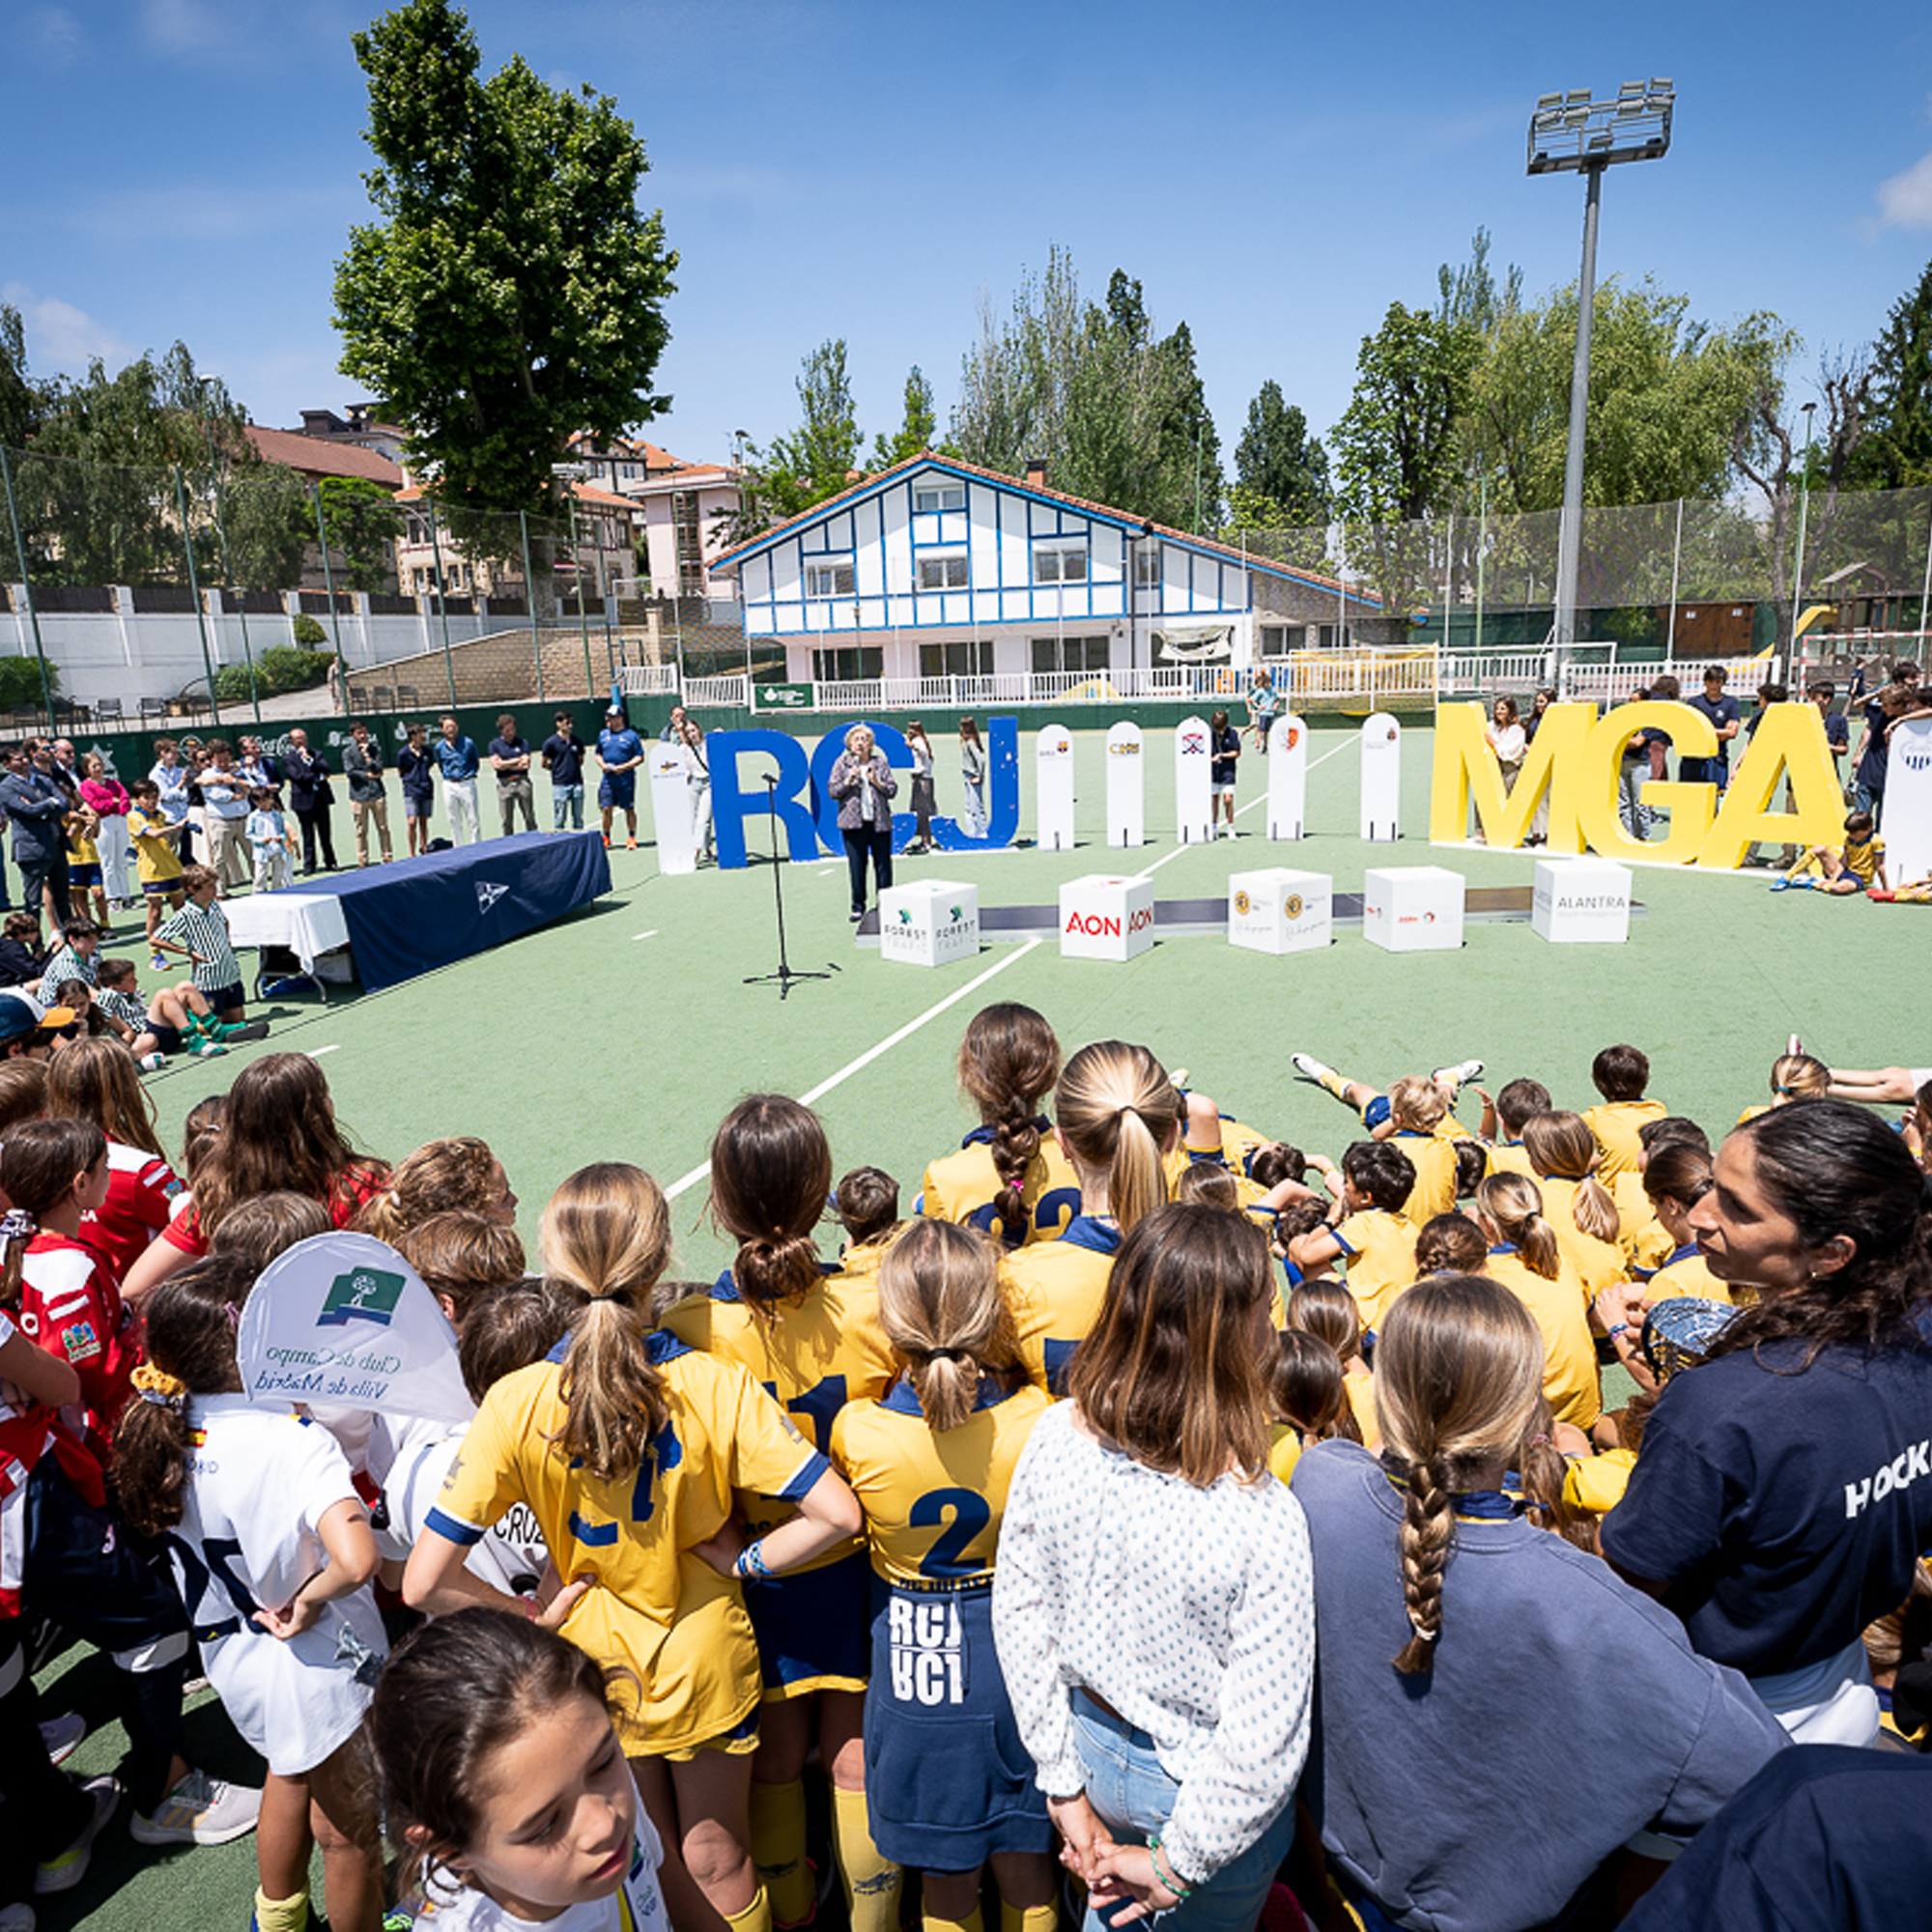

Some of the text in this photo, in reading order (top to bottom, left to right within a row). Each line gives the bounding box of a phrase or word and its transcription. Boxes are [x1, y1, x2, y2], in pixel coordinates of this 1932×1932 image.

[706, 716, 1020, 869] RCJ
[1430, 701, 1846, 870] MGA
[1557, 895, 1625, 909] ALANTRA
[884, 923, 927, 941] FOREST
[936, 919, 976, 939] FOREST
[1065, 911, 1121, 937] AON
[1127, 906, 1152, 935] AON
[1844, 1438, 1932, 1520] HOCK
[909, 1487, 991, 1578] 2
